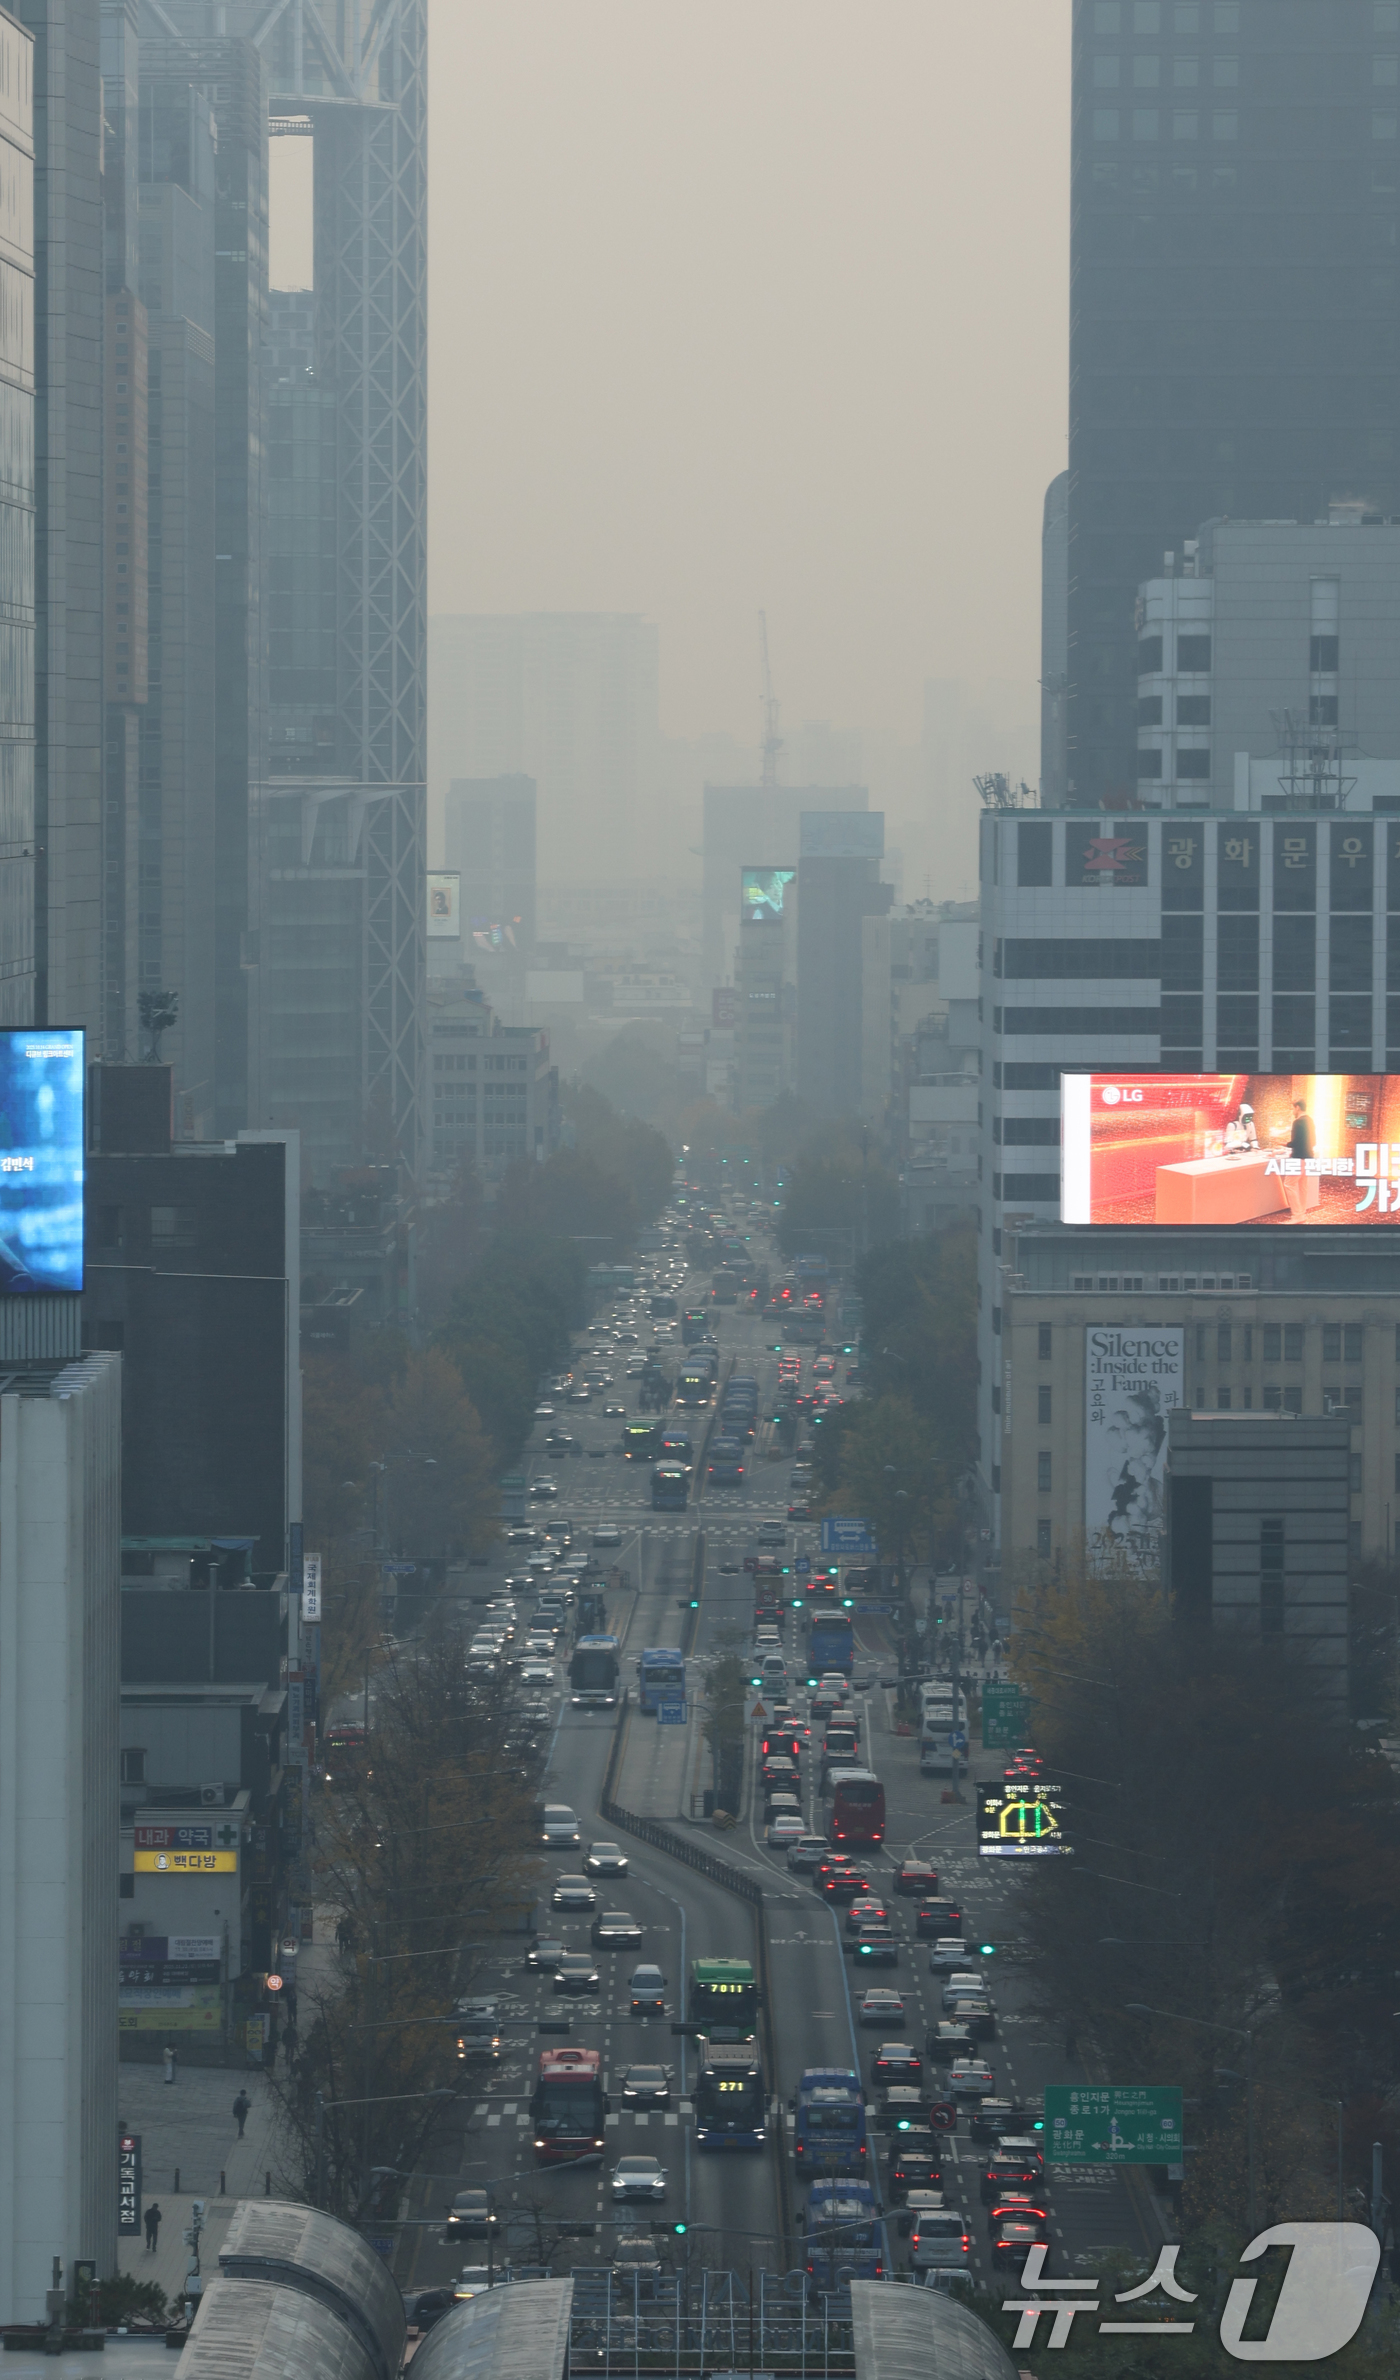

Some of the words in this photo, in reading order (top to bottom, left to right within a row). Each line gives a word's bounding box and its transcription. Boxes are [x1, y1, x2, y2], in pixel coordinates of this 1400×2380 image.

[1167, 837, 1400, 870] 광화문우
[1114, 875, 1141, 883] POST
[1123, 1088, 1143, 1102] LG
[1, 1156, 35, 1172] 김민석
[1264, 1158, 1302, 1176] AI로
[1305, 1157, 1354, 1176] 편리한
[1356, 1143, 1400, 1177] 미
[1091, 1332, 1179, 1358] Silence
[1091, 1358, 1148, 1374] :Inside
[1151, 1358, 1179, 1374] the
[1090, 1379, 1106, 1426] 고요와
[307, 1564, 317, 1615] 국제회계학원
[138, 1829, 170, 1846] 내과
[178, 1829, 209, 1846] 약국
[174, 1855, 217, 1869] 빽다방
[283, 1940, 297, 1952] 약
[711, 1984, 743, 1993] 7011
[719, 2082, 744, 2092] 271
[1069, 2091, 1110, 2103] 흥인지문
[1053, 2129, 1085, 2141] 광화문
[1053, 2140, 1082, 2150] 光化門
[120, 2153, 136, 2224] 기독교서점
